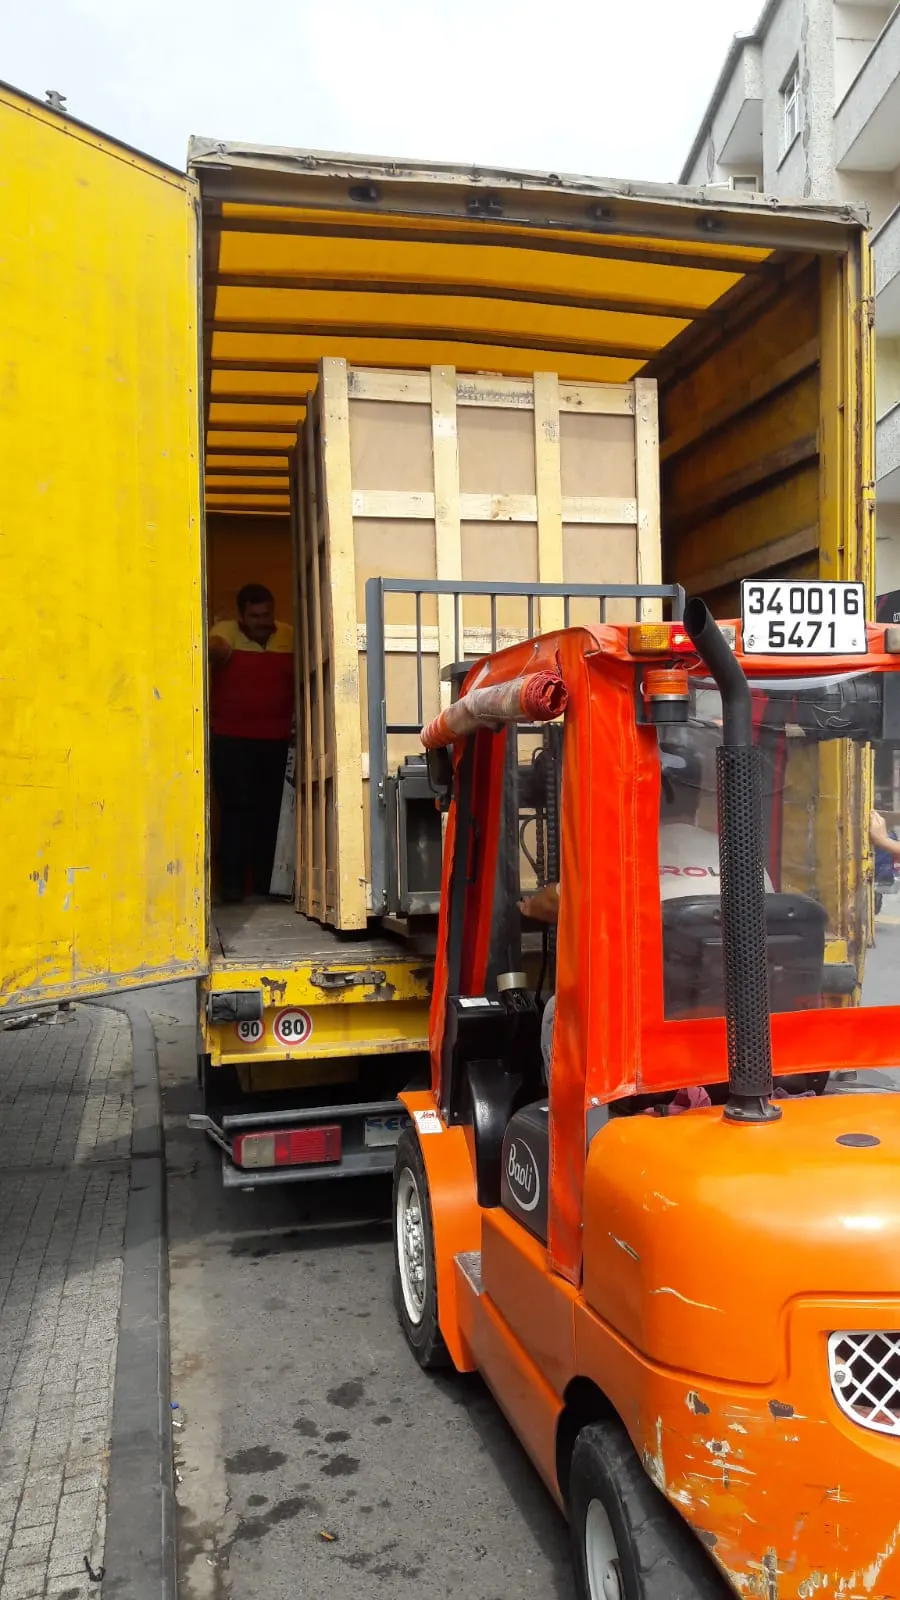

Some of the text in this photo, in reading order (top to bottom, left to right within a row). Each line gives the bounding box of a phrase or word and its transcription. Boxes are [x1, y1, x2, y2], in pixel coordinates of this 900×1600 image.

[768, 621, 836, 648] 5471
[241, 1021, 260, 1038] 90
[281, 1019, 305, 1037] 80
[508, 1143, 533, 1192] Baoli
